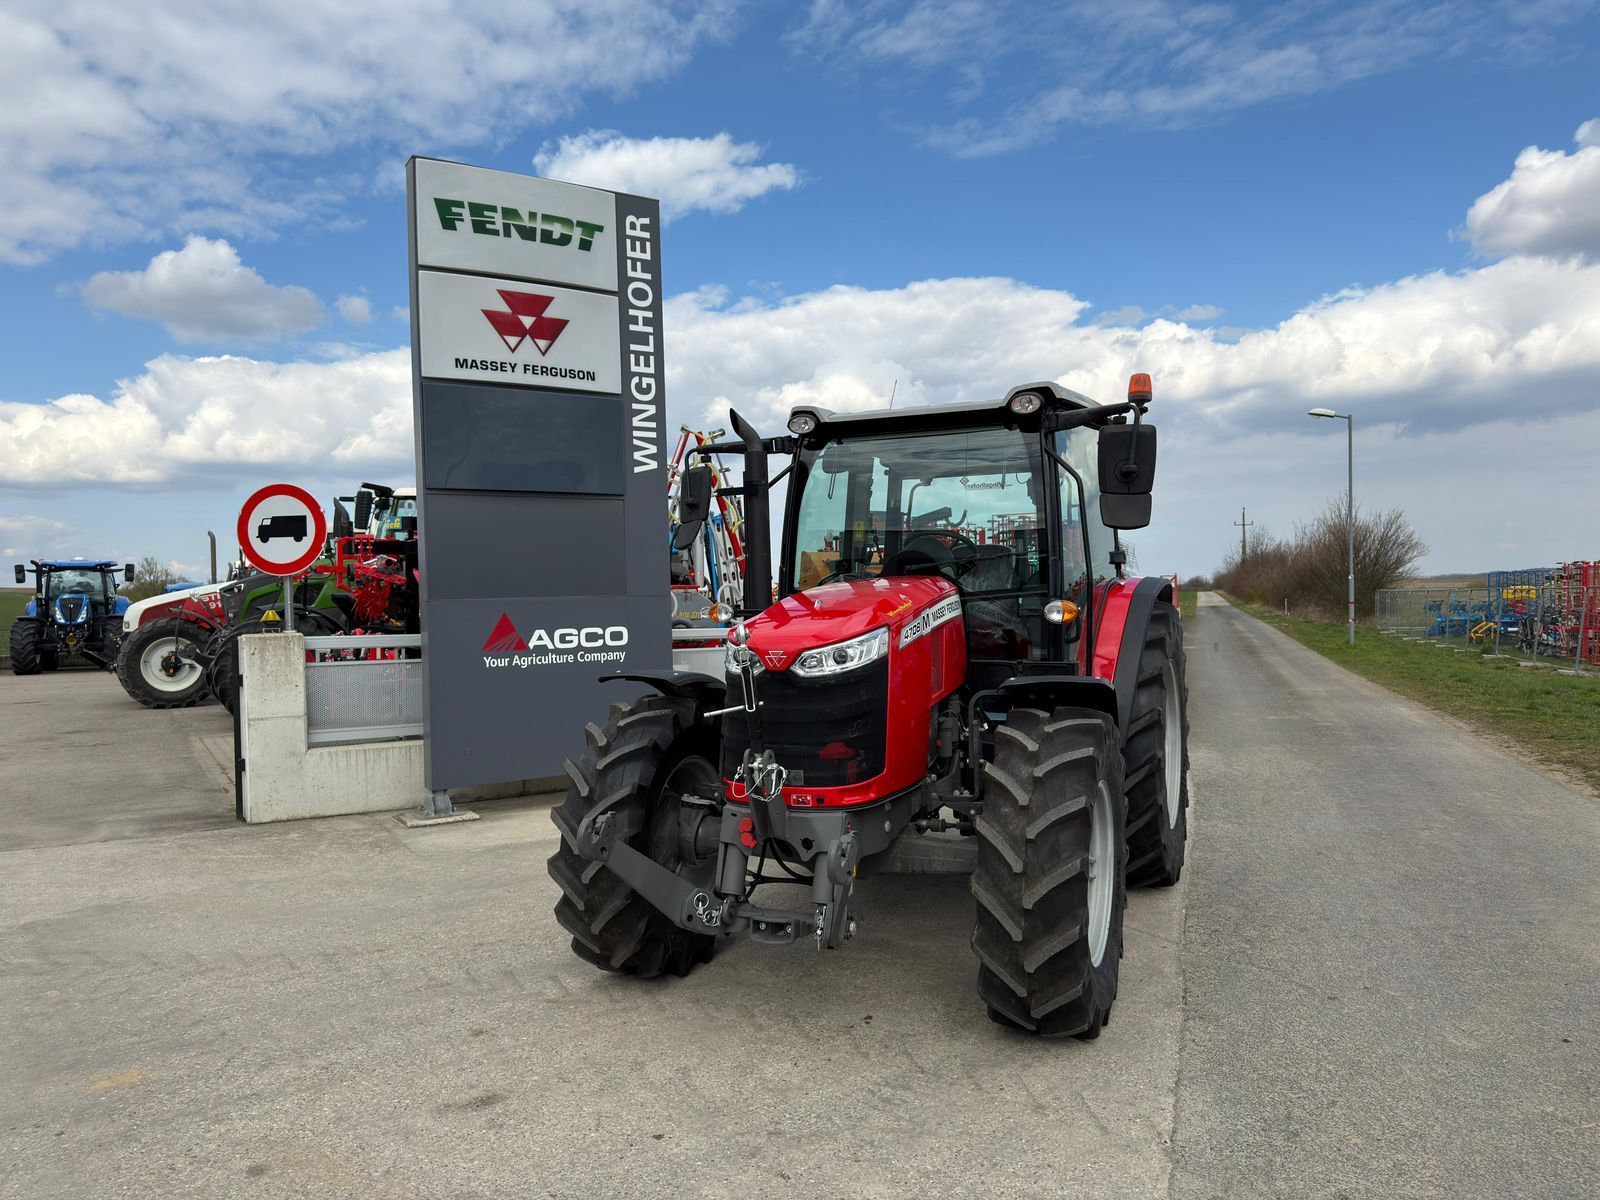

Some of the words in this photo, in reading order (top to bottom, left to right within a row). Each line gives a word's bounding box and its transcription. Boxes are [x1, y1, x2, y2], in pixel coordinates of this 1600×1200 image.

[433, 197, 604, 252] FENDT
[624, 214, 658, 474] WINGELHOFER
[454, 358, 518, 373] MASSEY
[523, 363, 596, 381] FERGUSON
[528, 626, 629, 650] AGCO
[904, 622, 920, 639] 4708
[922, 613, 930, 631] M
[483, 656, 510, 668] Your
[512, 653, 575, 668] Agriculture
[577, 651, 626, 663] Company
